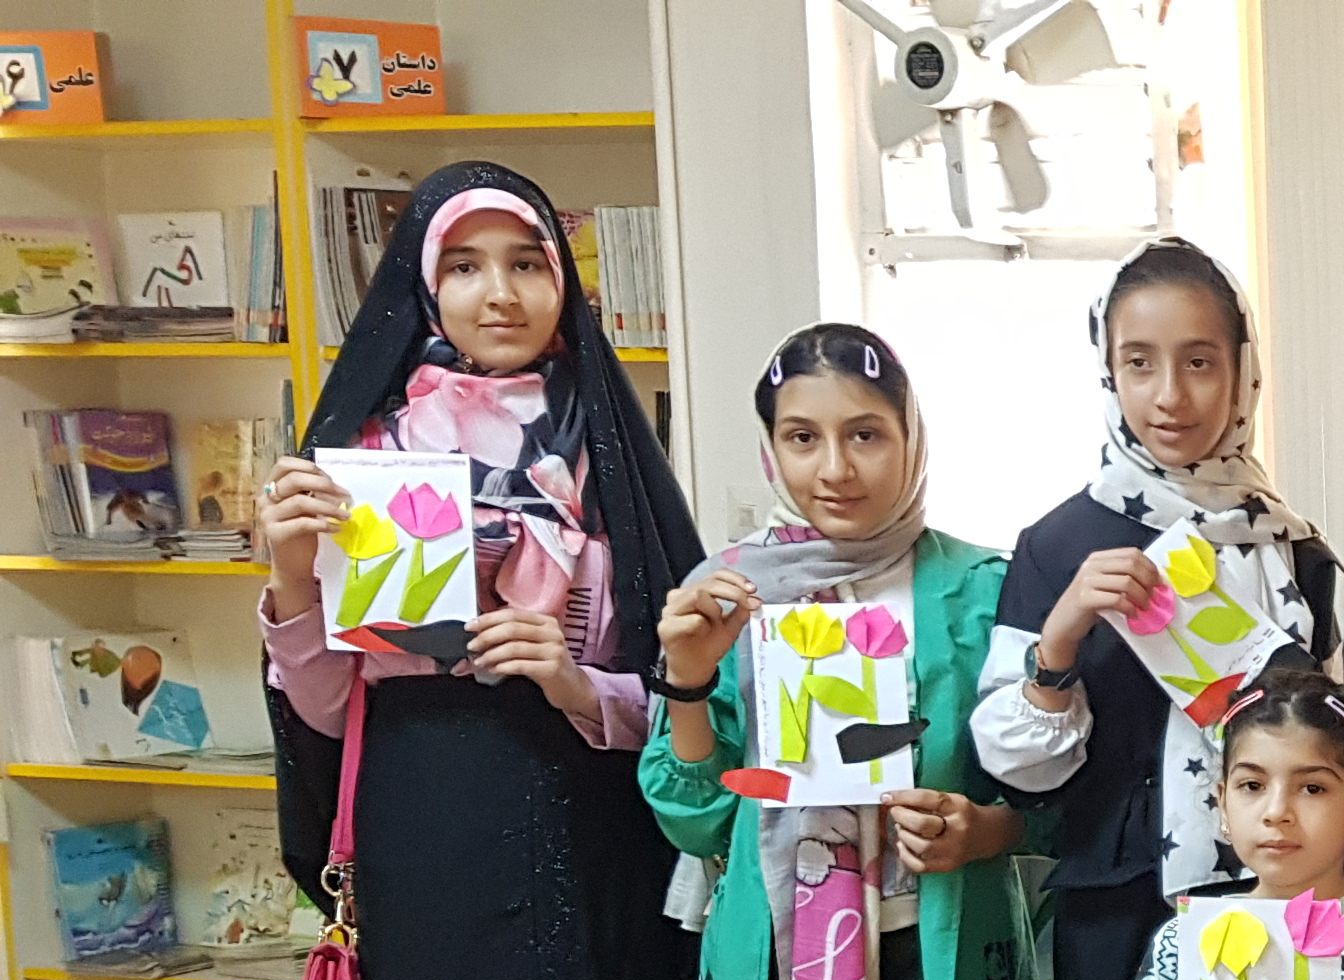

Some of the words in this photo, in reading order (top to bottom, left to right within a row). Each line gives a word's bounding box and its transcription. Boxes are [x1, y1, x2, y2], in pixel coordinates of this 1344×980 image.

[332, 48, 357, 82] ۷
[382, 52, 437, 74] داستان
[6, 60, 25, 95] ۶
[49, 67, 94, 93] علمی
[390, 78, 434, 98] علمی
